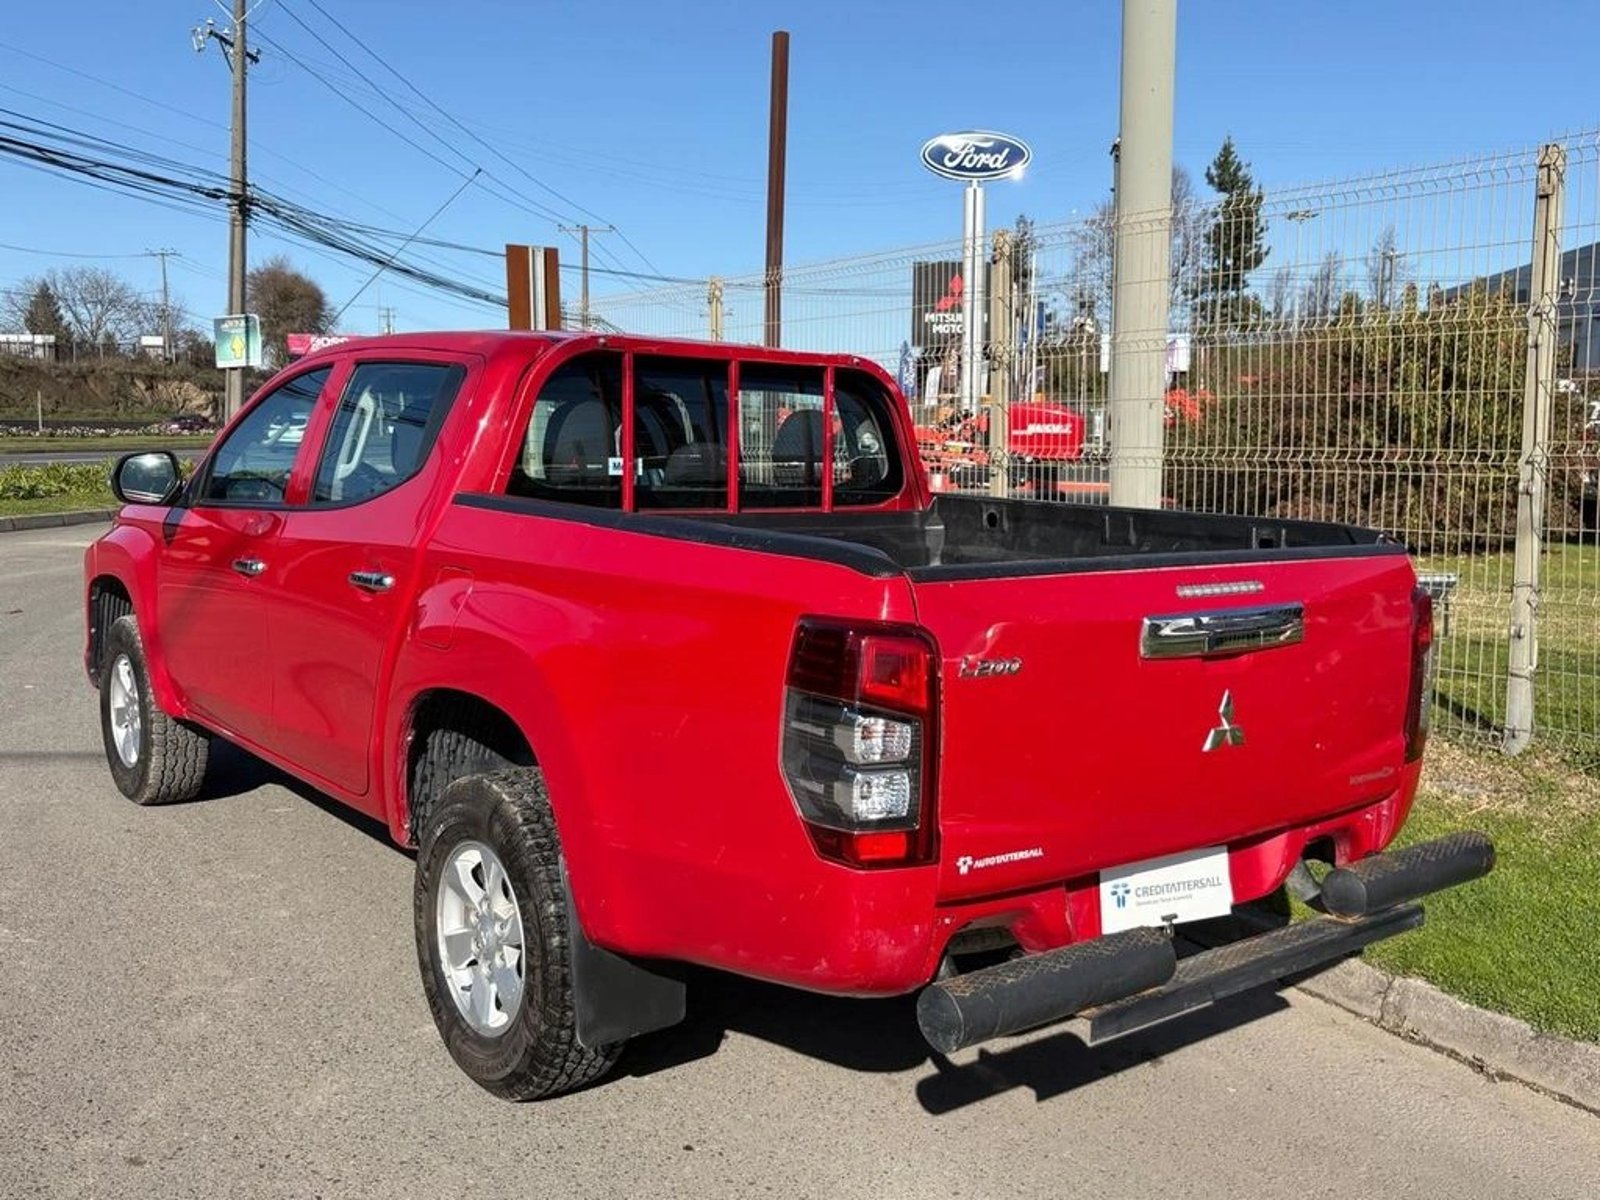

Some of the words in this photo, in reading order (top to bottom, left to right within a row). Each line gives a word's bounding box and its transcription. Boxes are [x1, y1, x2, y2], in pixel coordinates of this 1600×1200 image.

[943, 140, 1010, 169] Ford
[925, 313, 988, 323] MITSUI
[959, 655, 1023, 679] L200
[973, 847, 1044, 870] AUTOTATTERSALL
[1134, 876, 1223, 898] CREDITATTERSALL
